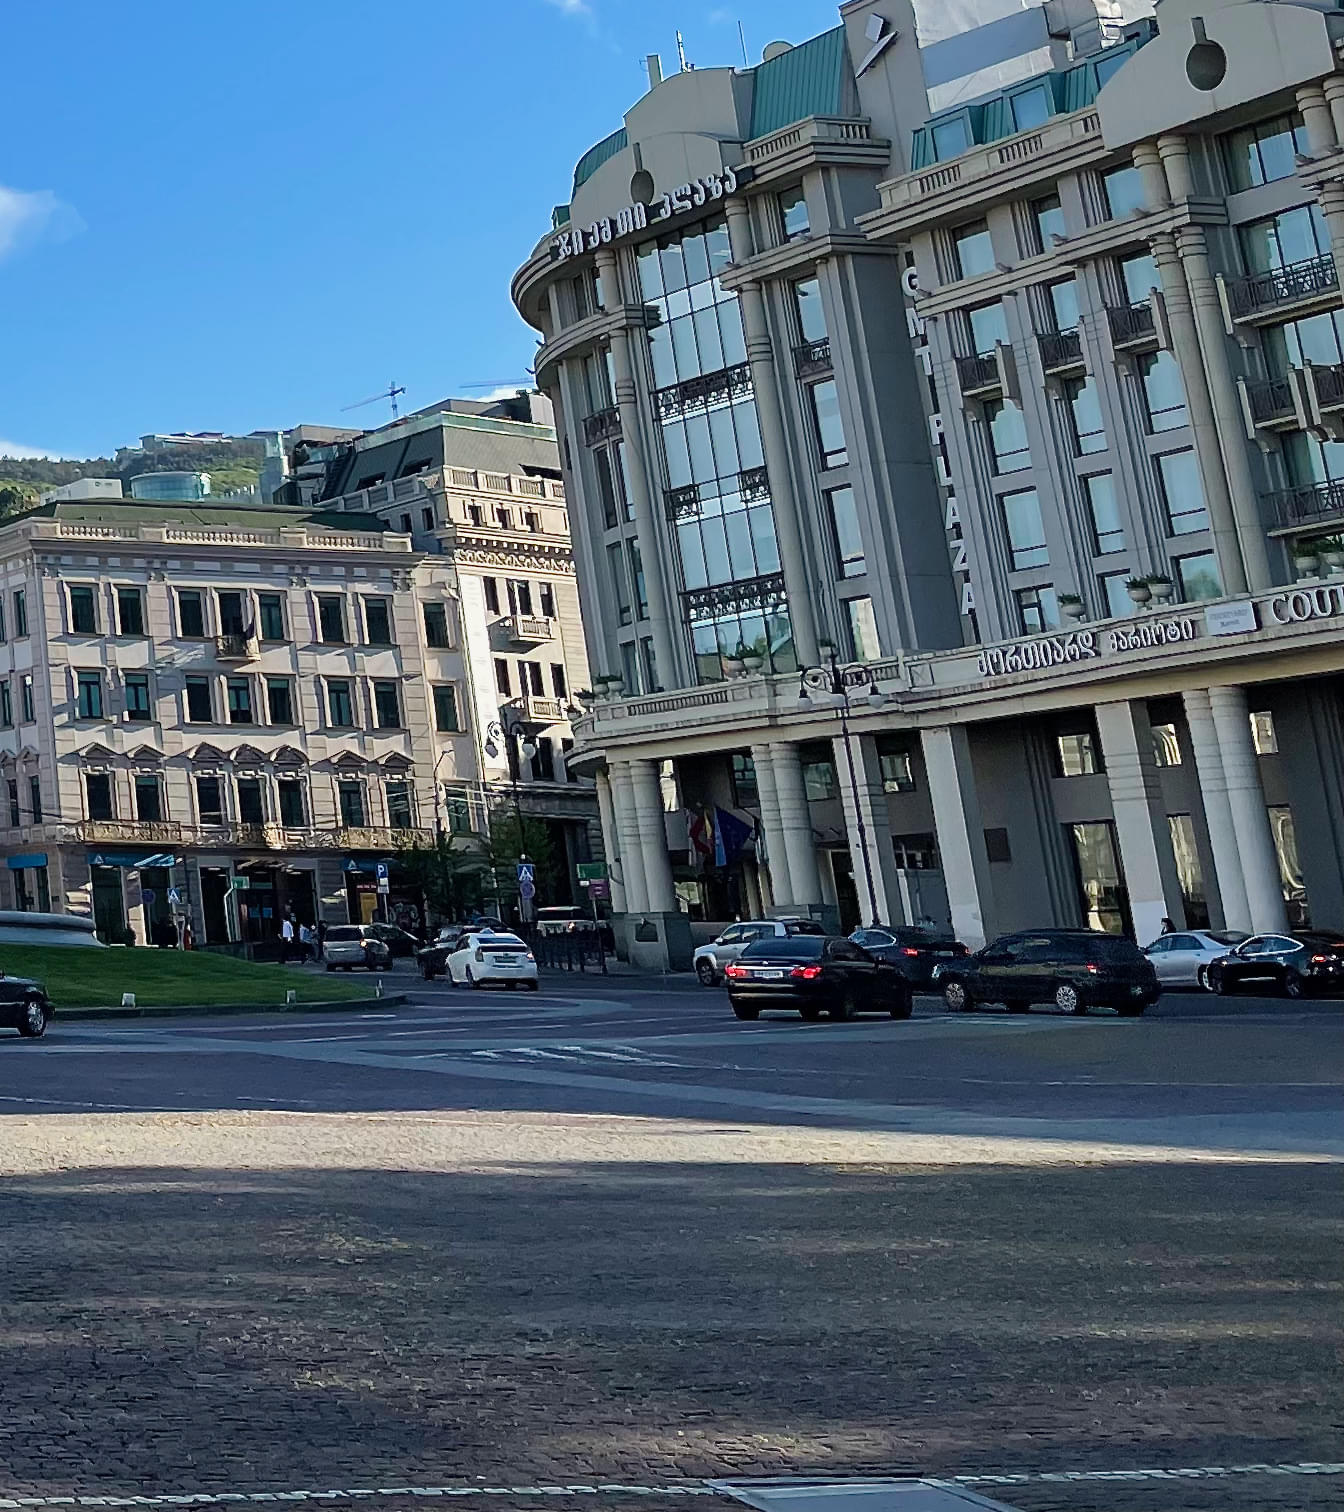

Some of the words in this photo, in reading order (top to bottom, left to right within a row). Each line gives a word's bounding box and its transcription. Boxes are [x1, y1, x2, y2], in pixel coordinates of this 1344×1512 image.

[660, 166, 737, 219] პლაზა
[928, 413, 976, 615] PLAZA
[1109, 619, 1193, 652] მარიოტი
[377, 865, 385, 877] P
